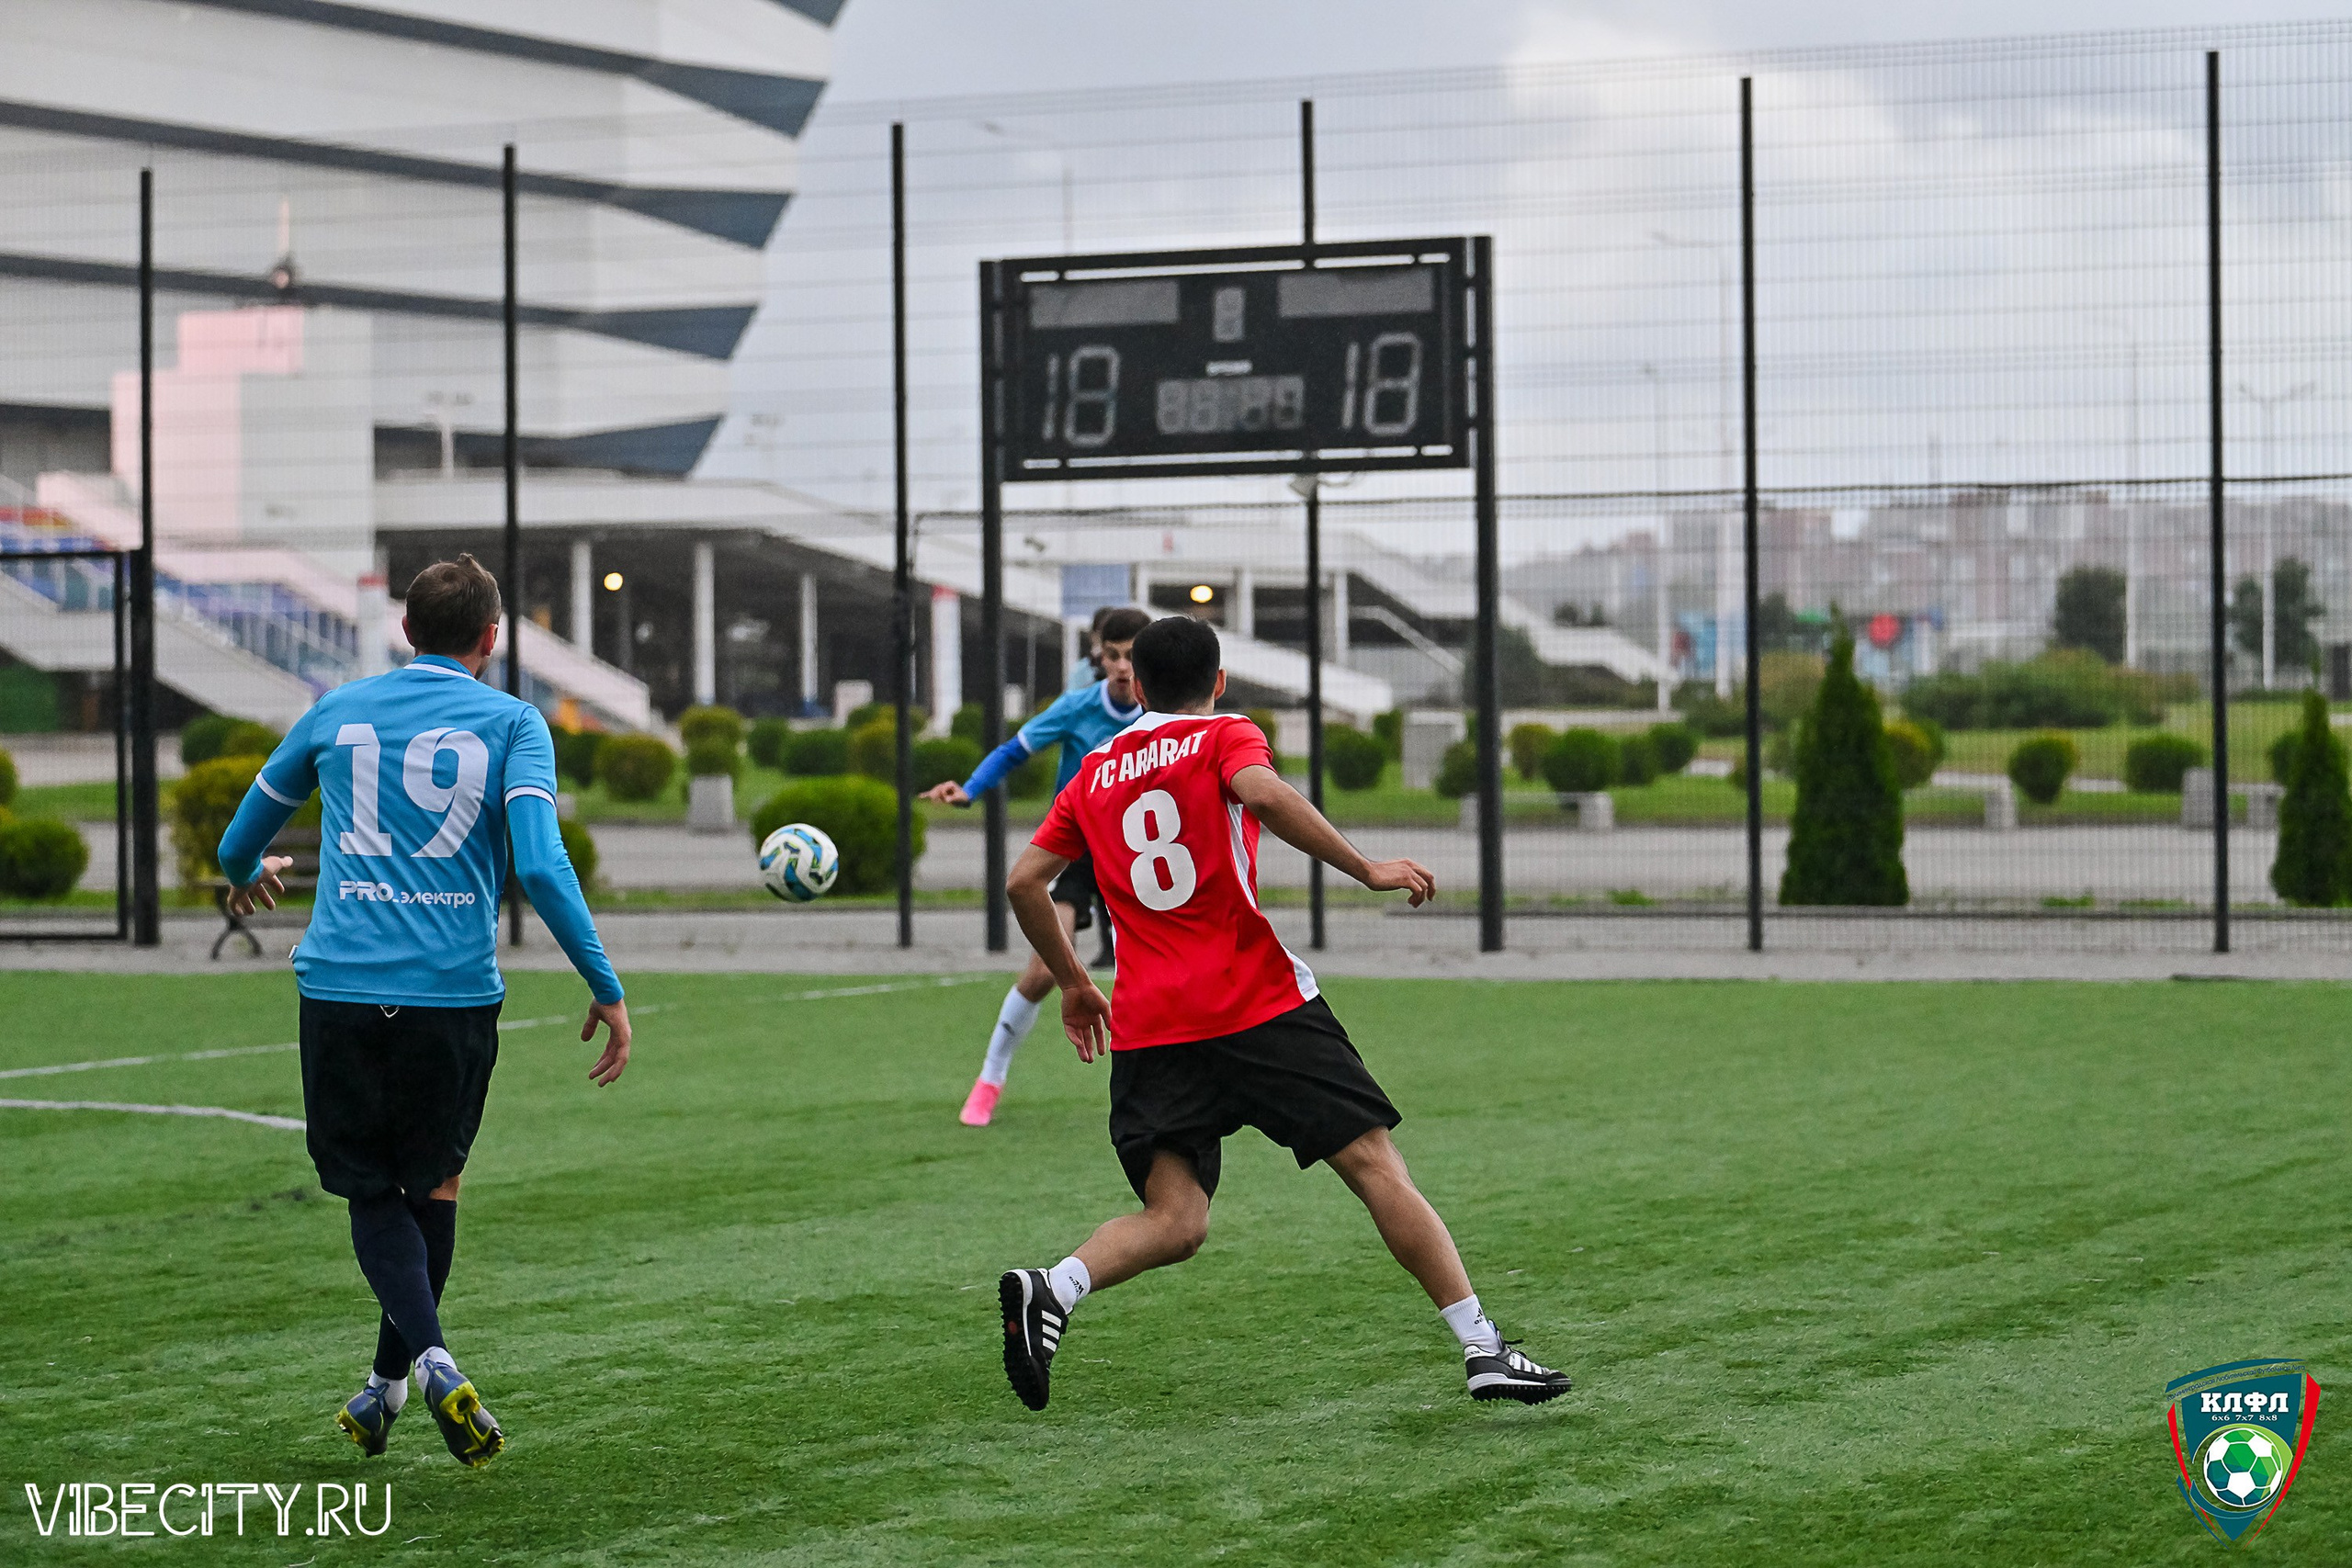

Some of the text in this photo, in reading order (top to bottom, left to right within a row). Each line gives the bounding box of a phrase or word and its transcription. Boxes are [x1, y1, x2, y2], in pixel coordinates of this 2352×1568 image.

[334, 723, 490, 858] 19
[1090, 730, 1208, 794] FC ARARAT
[1122, 789, 1197, 911] 8
